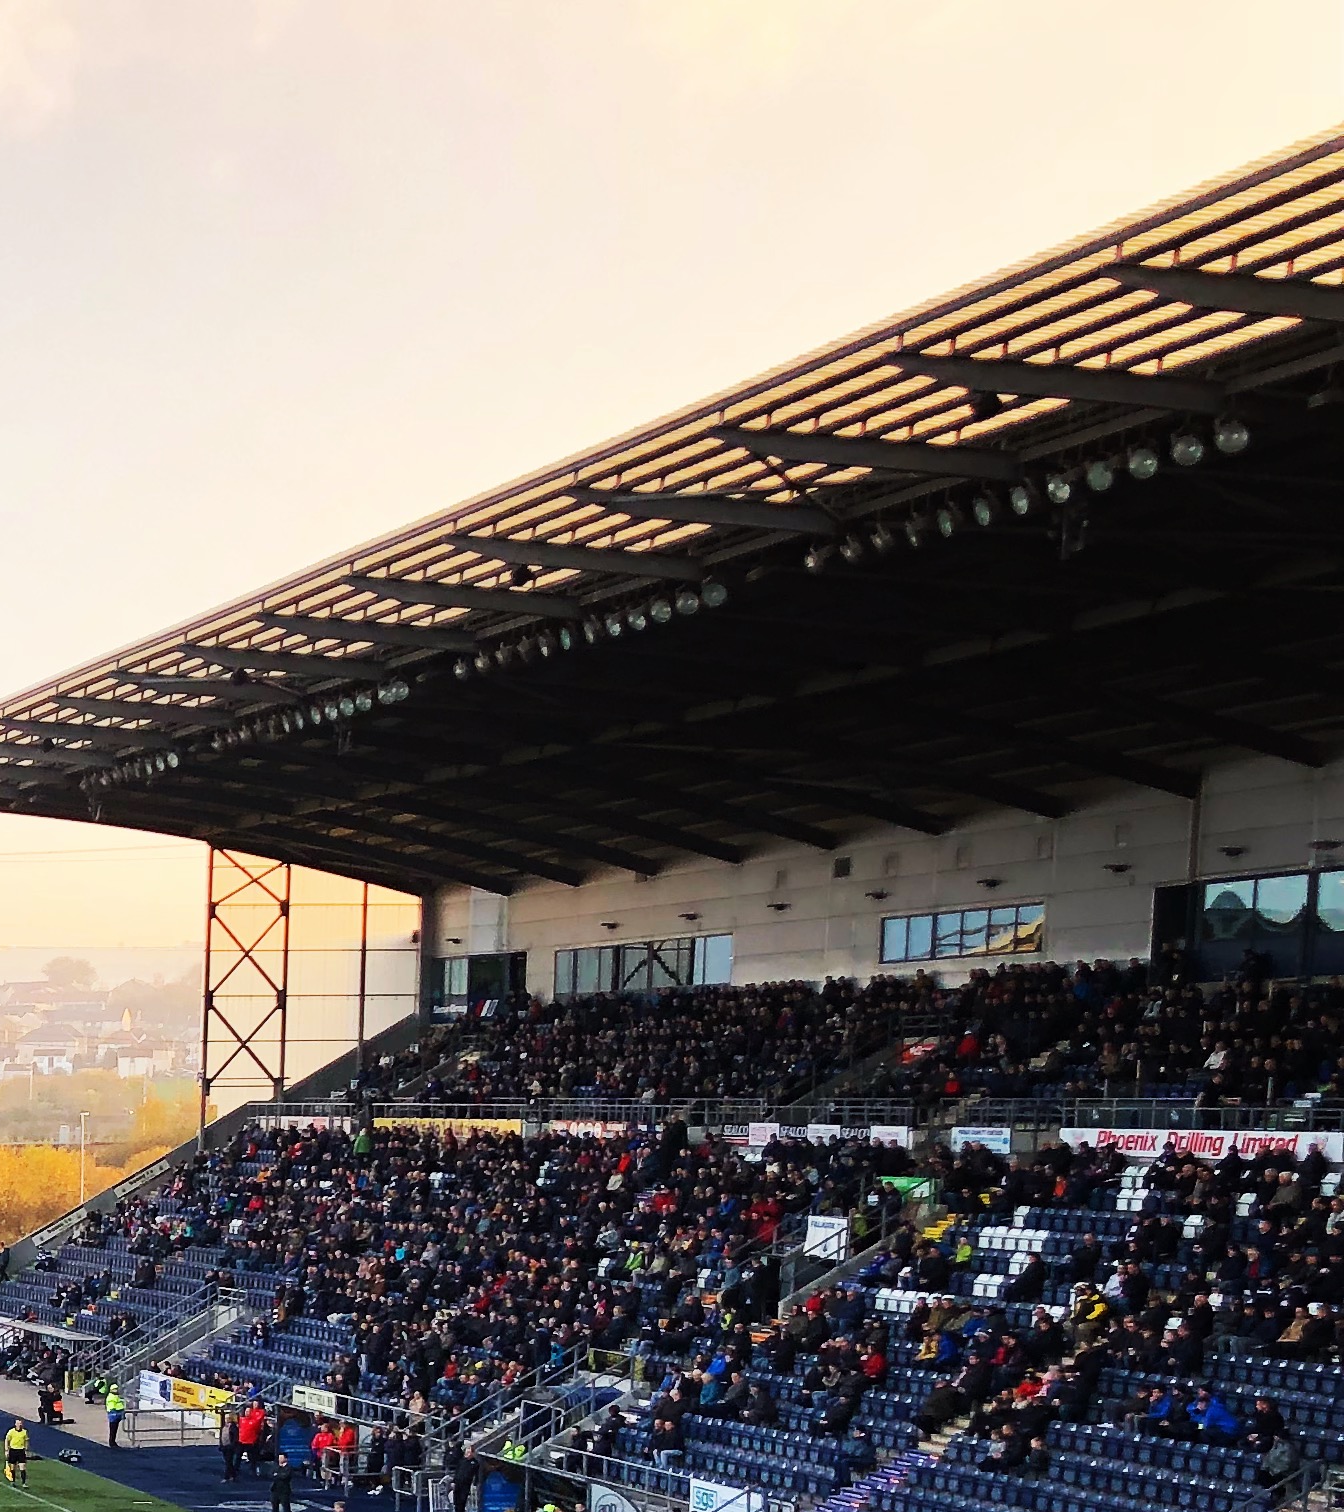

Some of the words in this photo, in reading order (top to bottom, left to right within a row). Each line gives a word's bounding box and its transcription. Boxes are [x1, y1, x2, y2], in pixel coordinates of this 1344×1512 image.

[1097, 1130, 1159, 1152] Phoenix
[1166, 1131, 1224, 1156] Drilling
[1232, 1133, 1299, 1154] Limited
